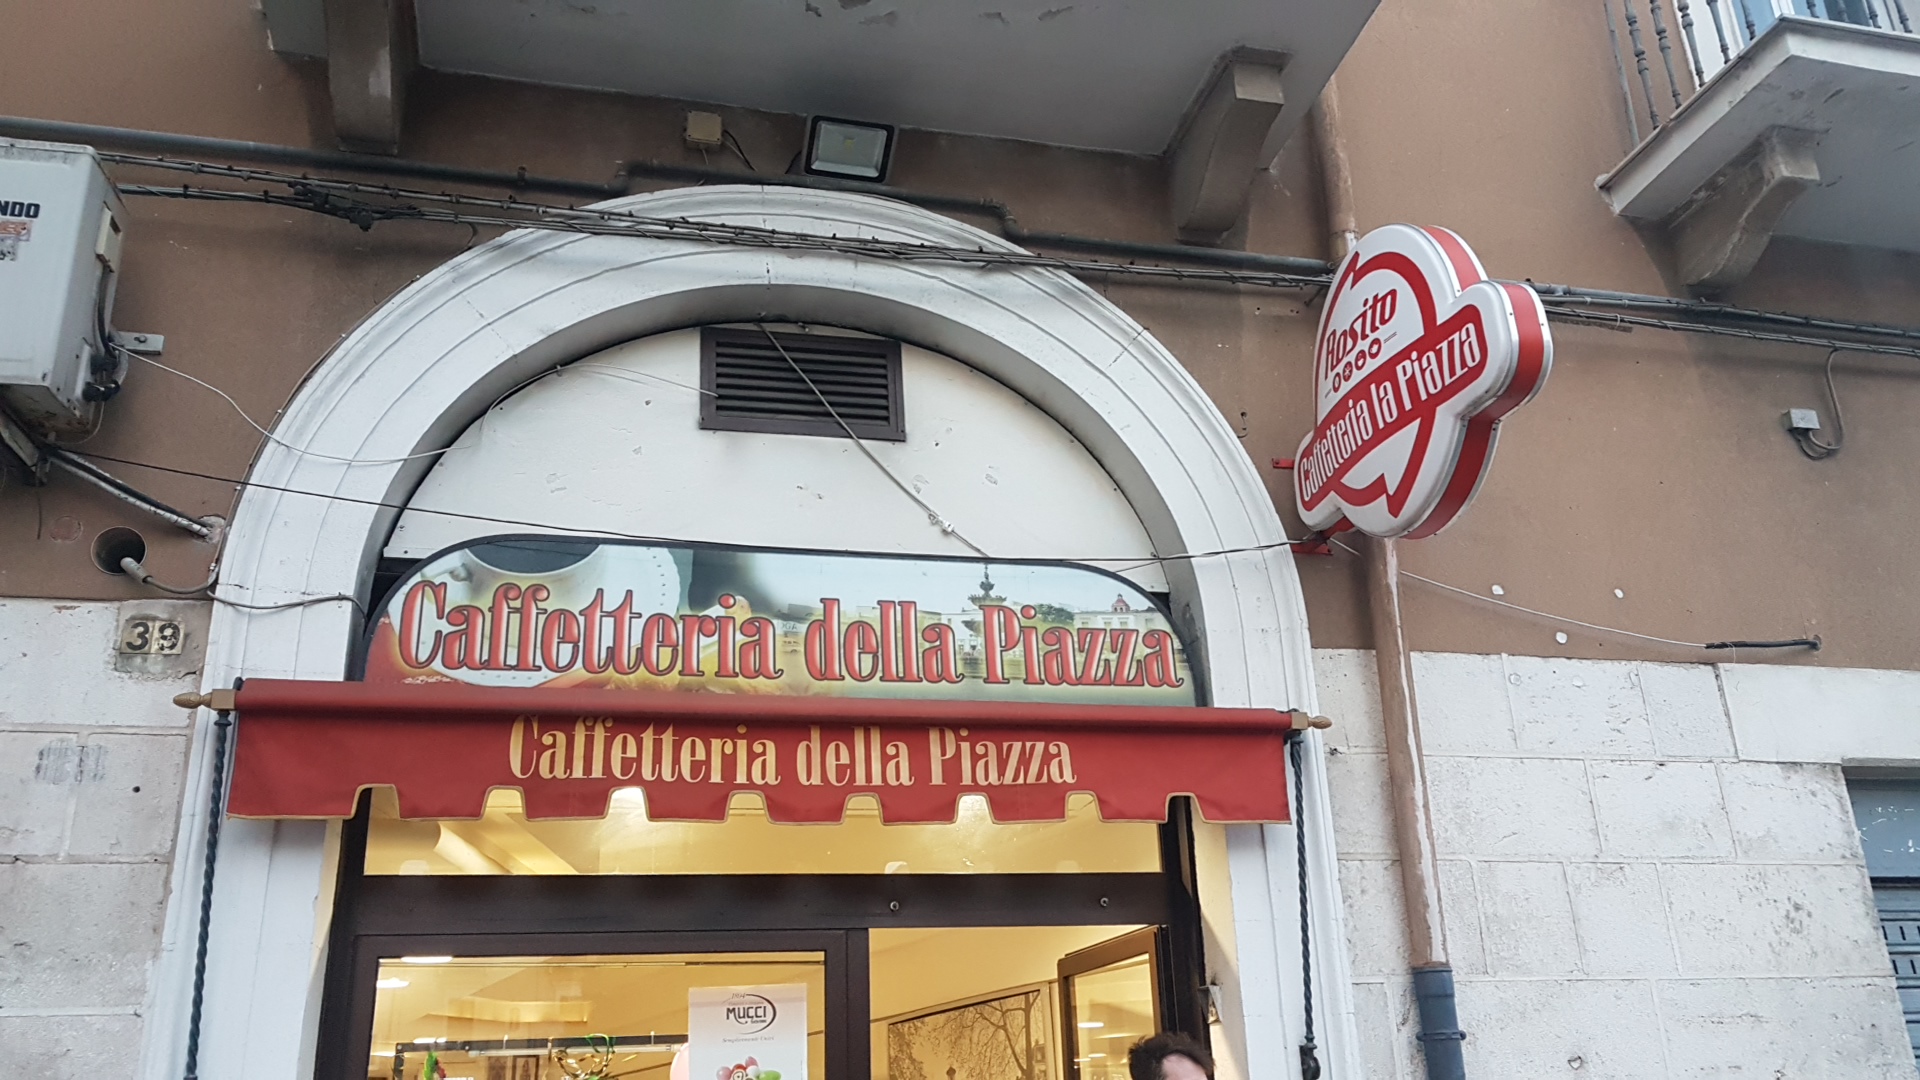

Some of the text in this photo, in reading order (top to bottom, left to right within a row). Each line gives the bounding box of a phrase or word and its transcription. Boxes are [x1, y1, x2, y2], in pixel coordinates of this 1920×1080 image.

[1325, 288, 1398, 380] Rosito
[1301, 322, 1482, 502] Caffetteria la Piazza
[125, 621, 181, 651] 39
[401, 579, 1185, 688] Caffetteria della Piazza
[508, 714, 1077, 787] Caffetteria della Piazza
[726, 1005, 767, 1023] MUCCI
